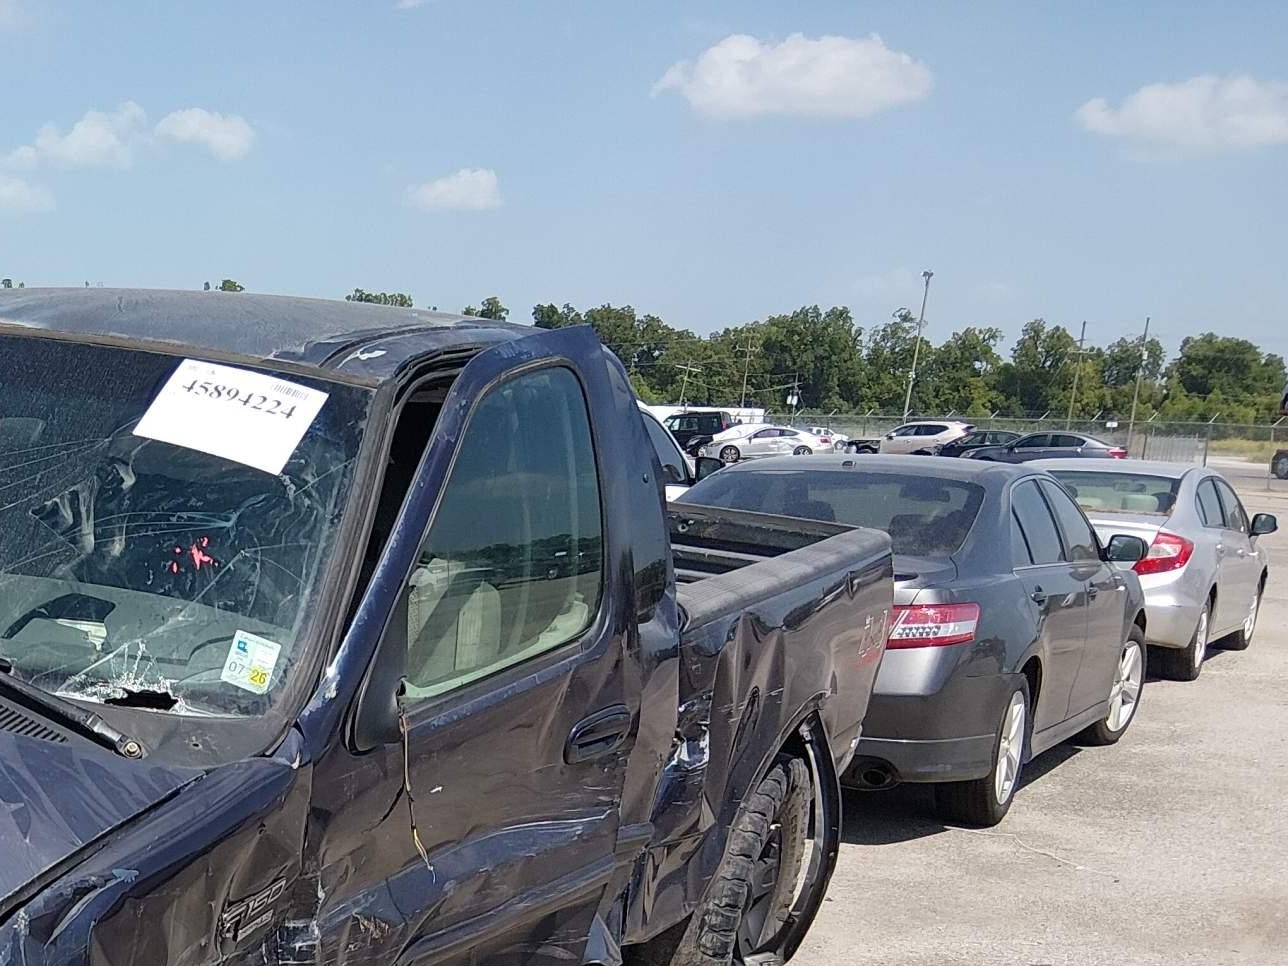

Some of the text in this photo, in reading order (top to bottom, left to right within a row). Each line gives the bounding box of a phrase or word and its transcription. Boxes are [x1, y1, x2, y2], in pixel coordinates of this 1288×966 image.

[182, 380, 297, 419] 45894224
[228, 661, 267, 685] 07 26
